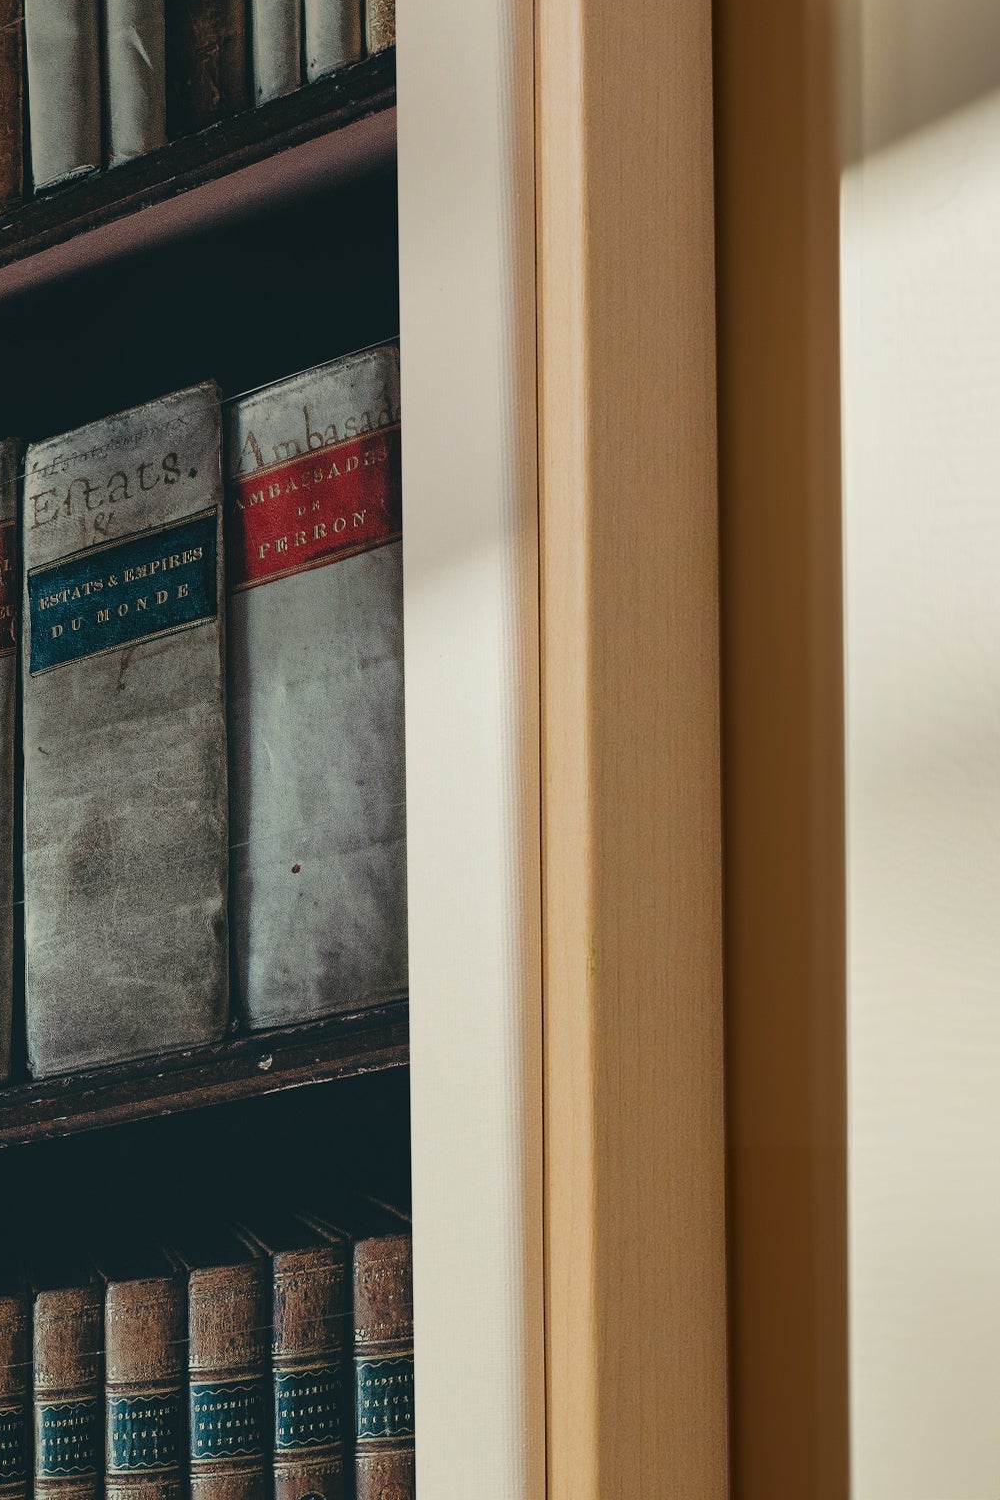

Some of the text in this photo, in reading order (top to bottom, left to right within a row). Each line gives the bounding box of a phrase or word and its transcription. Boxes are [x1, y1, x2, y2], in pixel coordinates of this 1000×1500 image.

[297, 499, 320, 516] DE
[257, 510, 367, 561] PERRON
[38, 547, 204, 611] ESTATS & EMPIRES
[50, 583, 190, 640] DU MONDE
